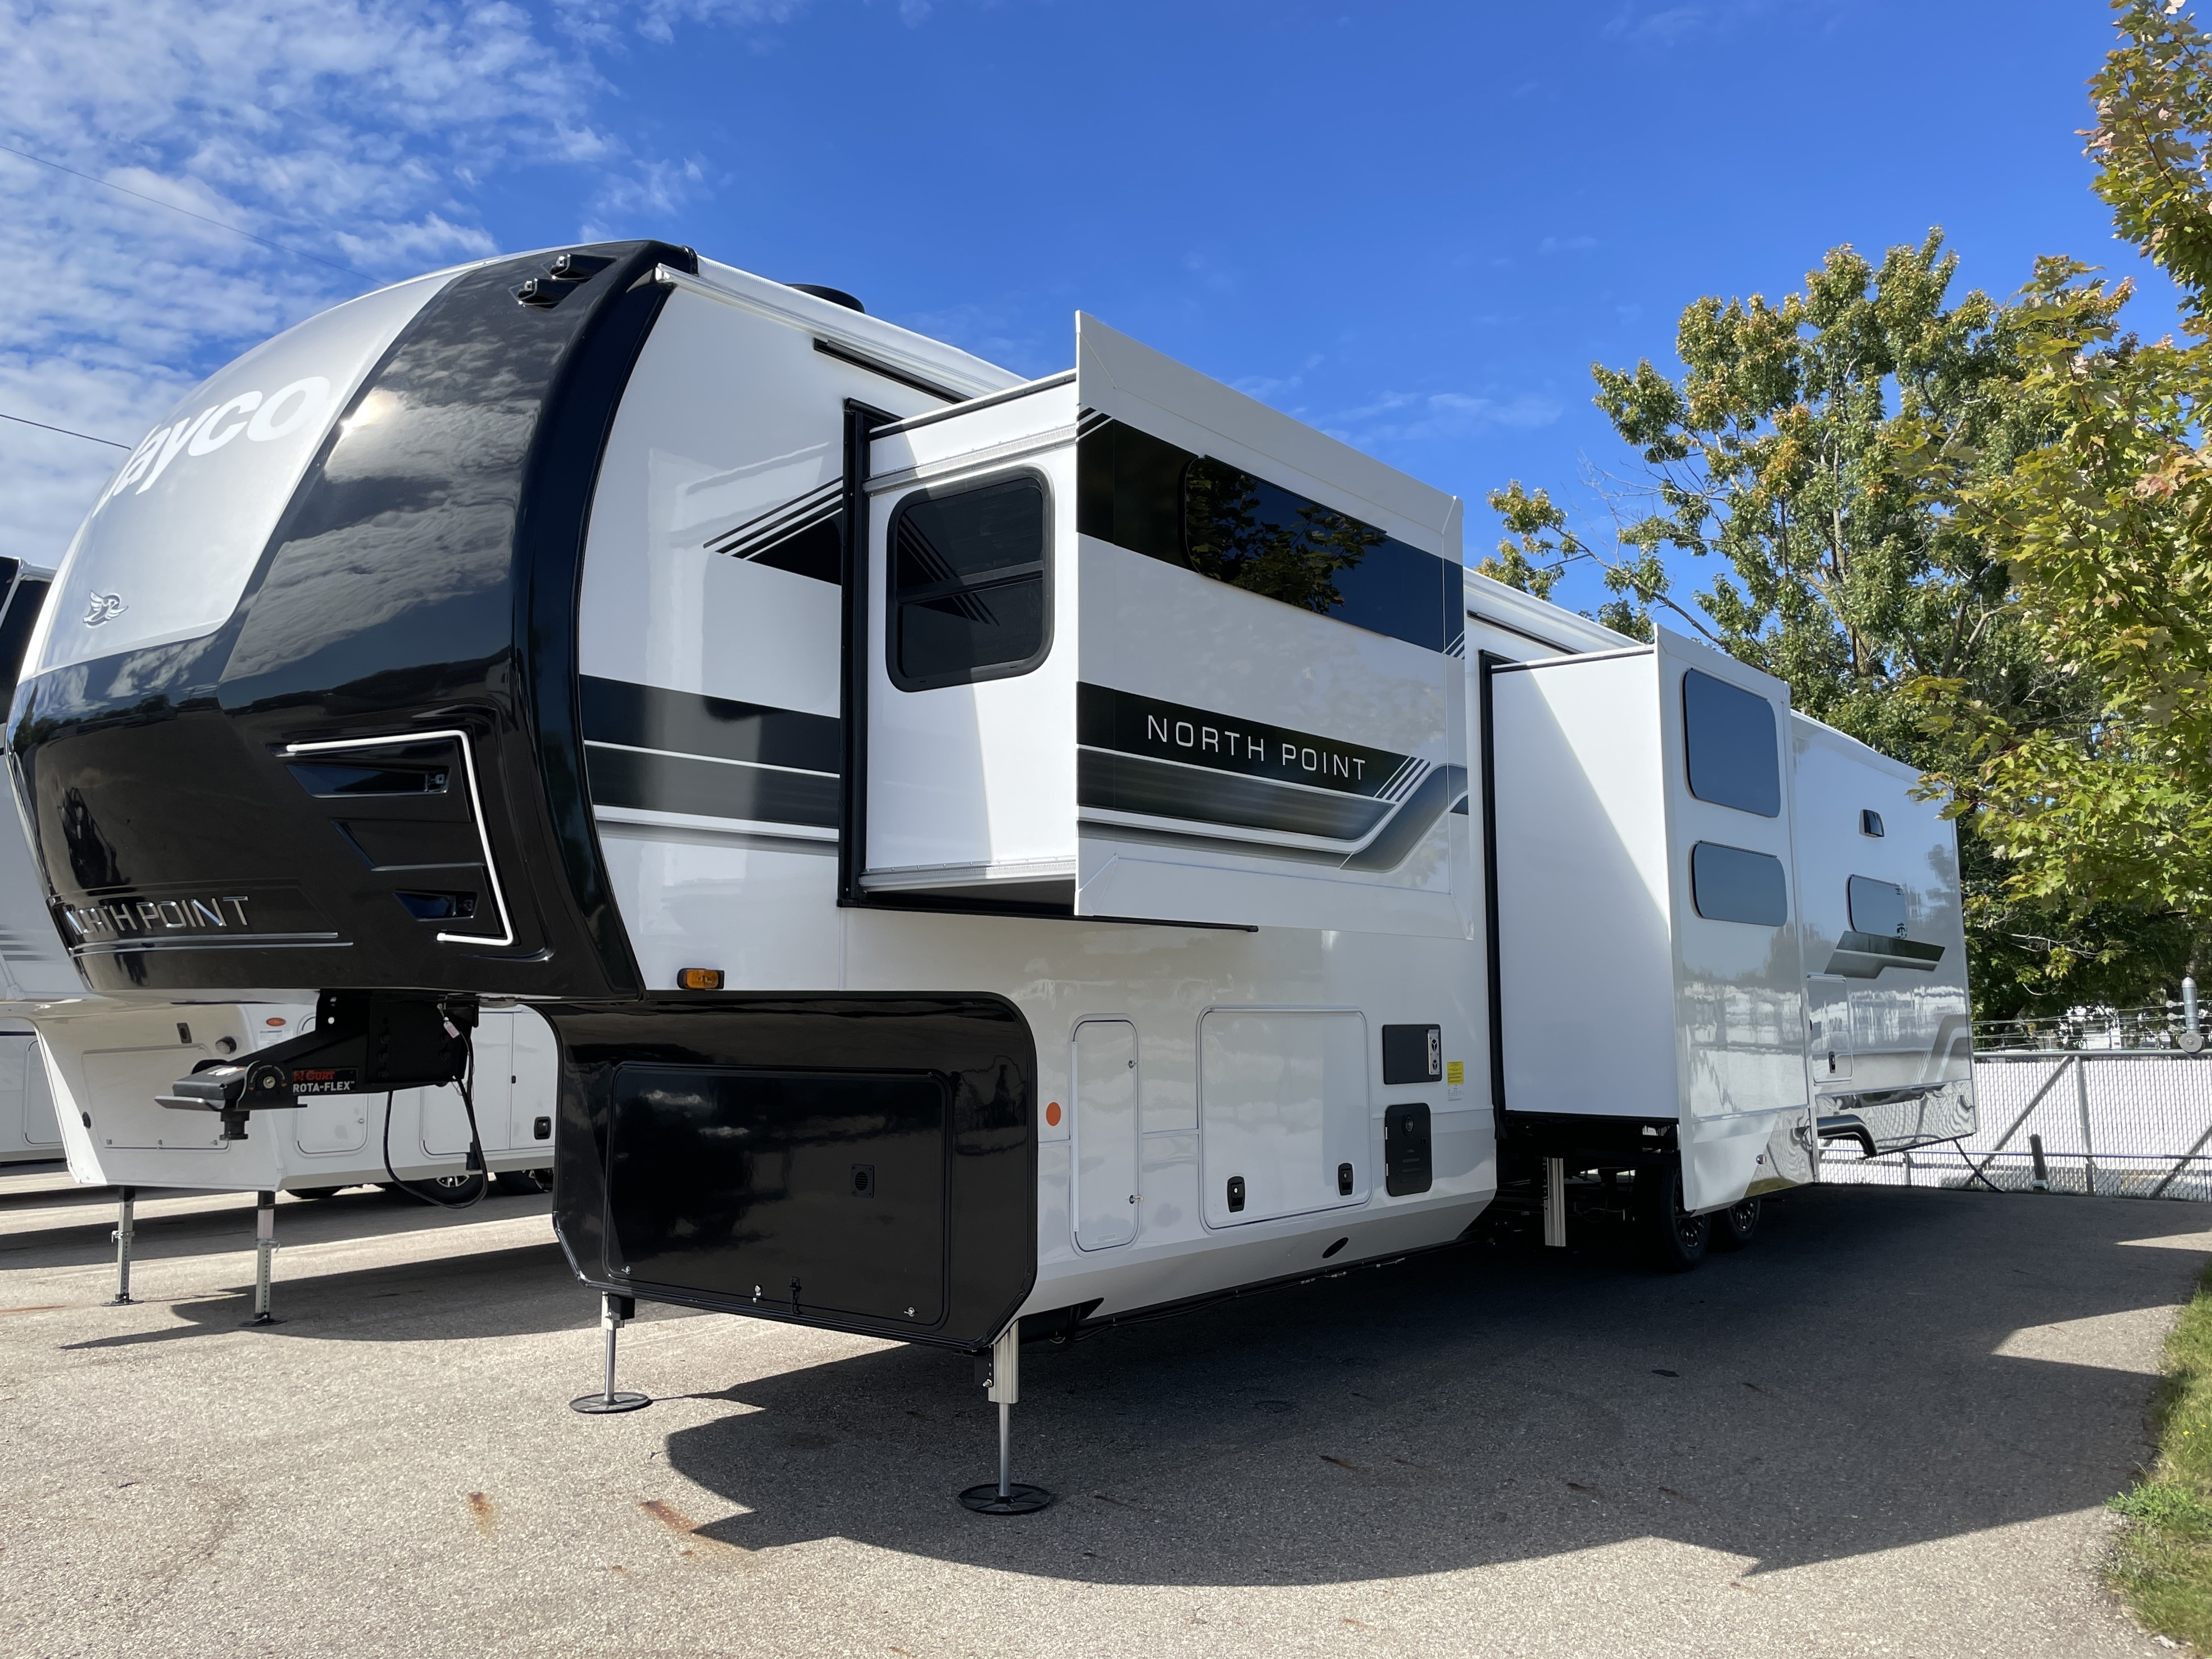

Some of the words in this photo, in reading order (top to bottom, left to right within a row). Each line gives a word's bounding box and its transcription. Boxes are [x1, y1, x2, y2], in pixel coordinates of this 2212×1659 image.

[1148, 715, 1264, 761] NORTH
[1283, 743, 1365, 780] POINT
[137, 896, 249, 929] POINT
